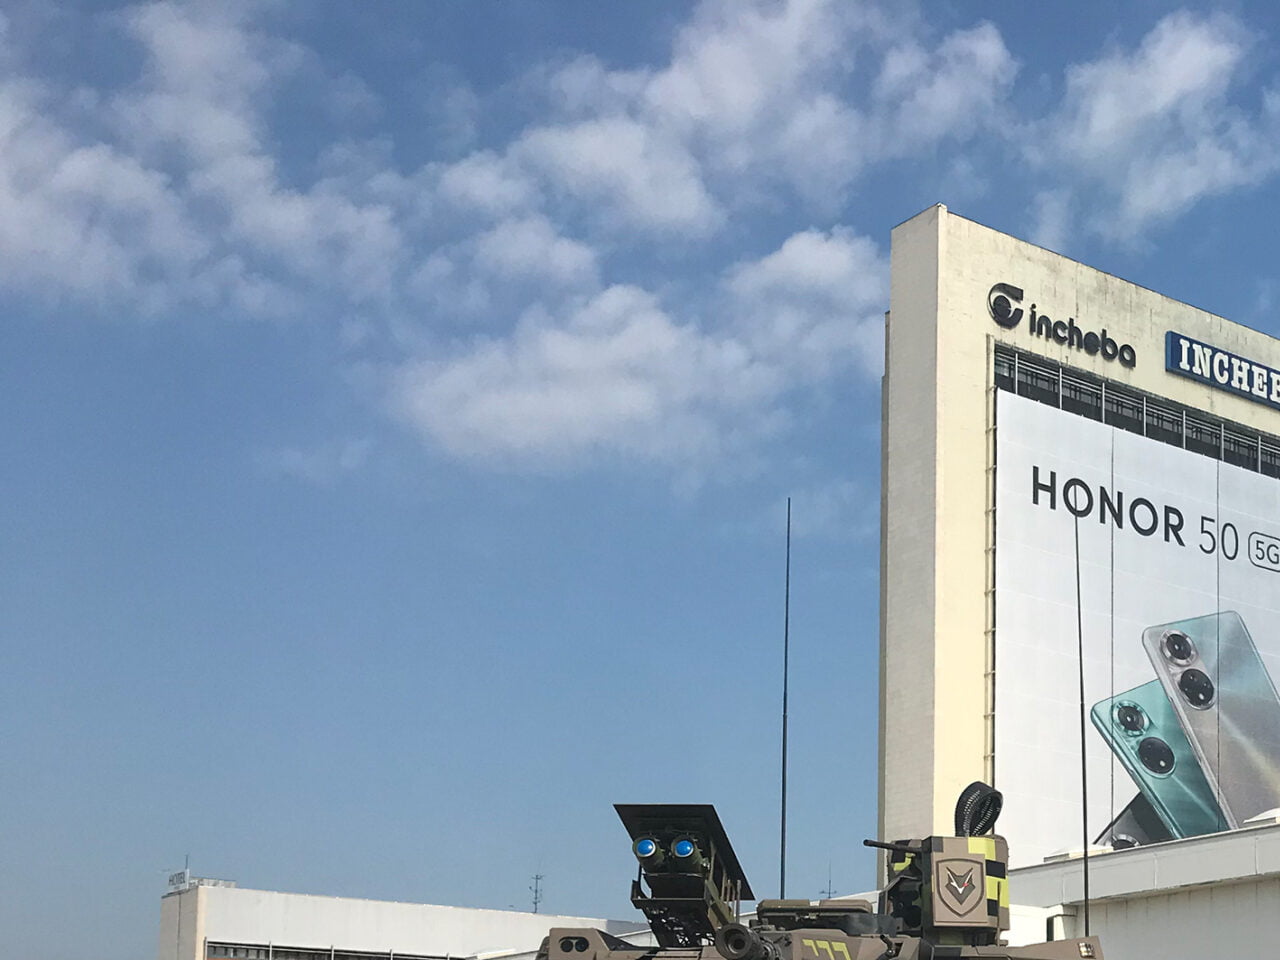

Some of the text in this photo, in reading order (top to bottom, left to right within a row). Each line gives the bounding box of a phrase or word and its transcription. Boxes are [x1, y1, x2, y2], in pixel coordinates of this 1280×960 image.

[1032, 465, 1280, 565] HONOR 50 5G
